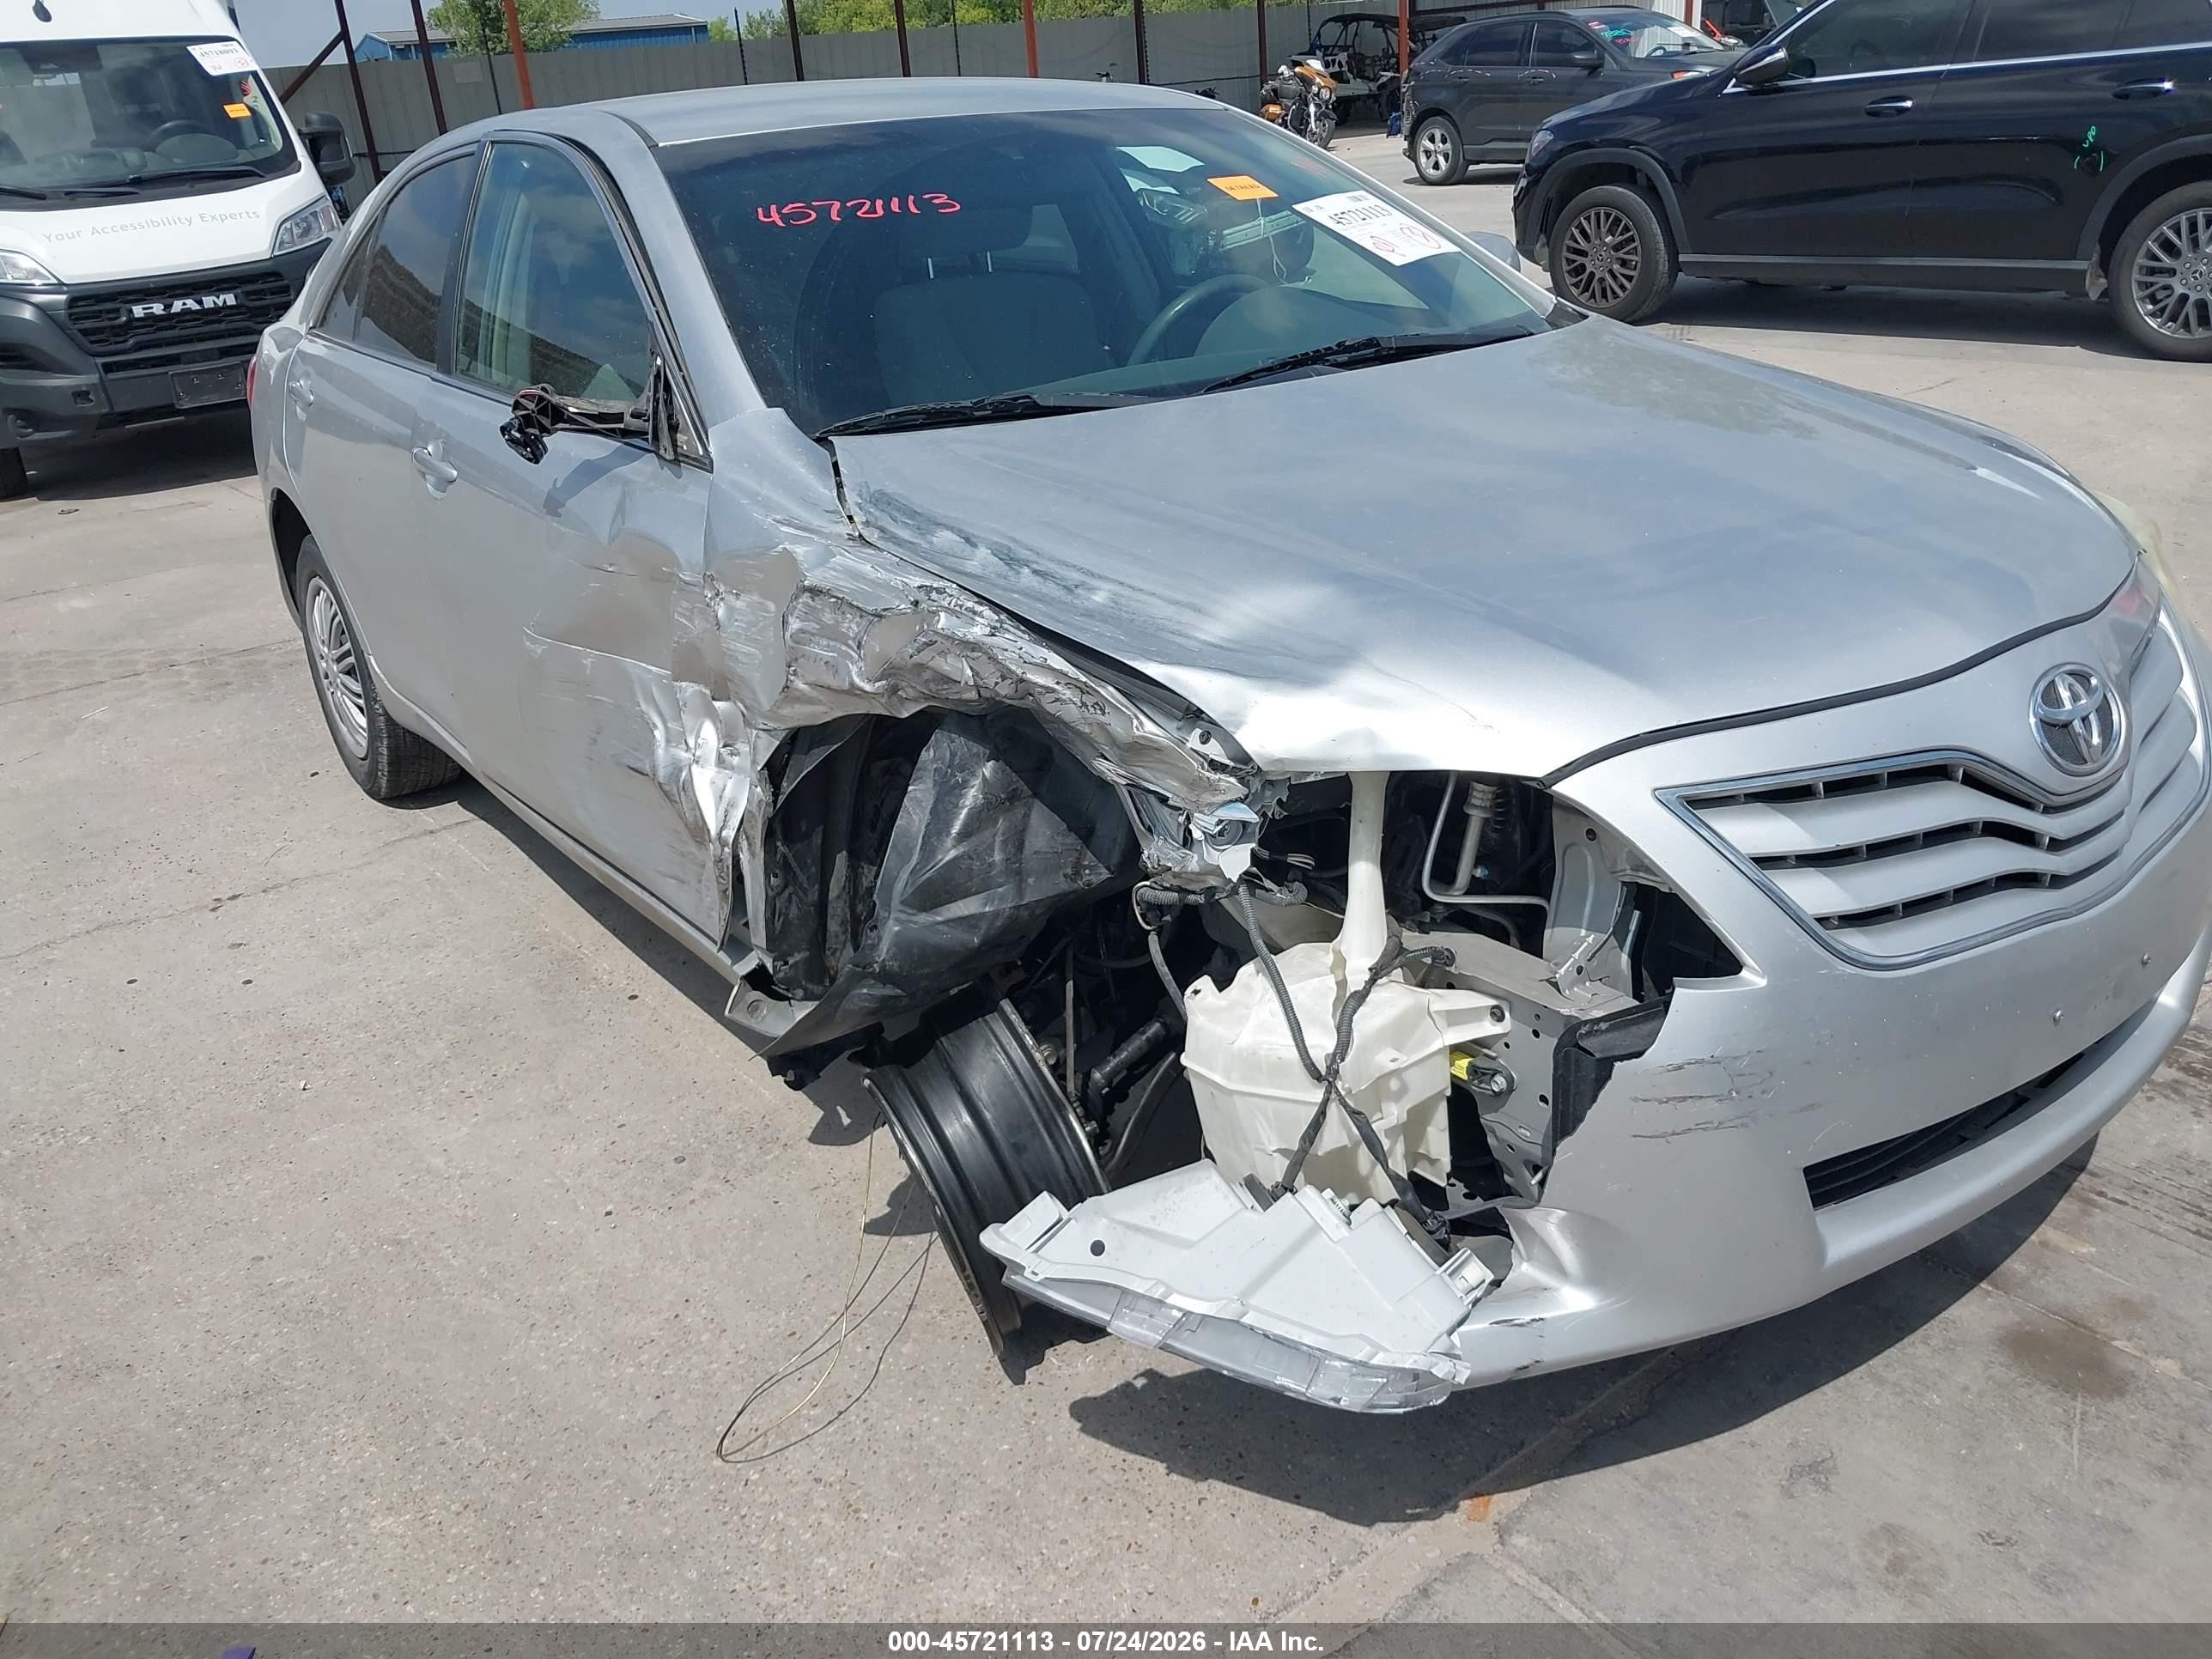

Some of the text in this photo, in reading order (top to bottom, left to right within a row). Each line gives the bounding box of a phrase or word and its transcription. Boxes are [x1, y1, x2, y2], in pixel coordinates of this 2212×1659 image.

[756, 192, 962, 227] 45721113
[1328, 204, 1394, 227] 45721113
[43, 210, 260, 244] Your Accessibility Experts
[131, 293, 237, 319] RAM
